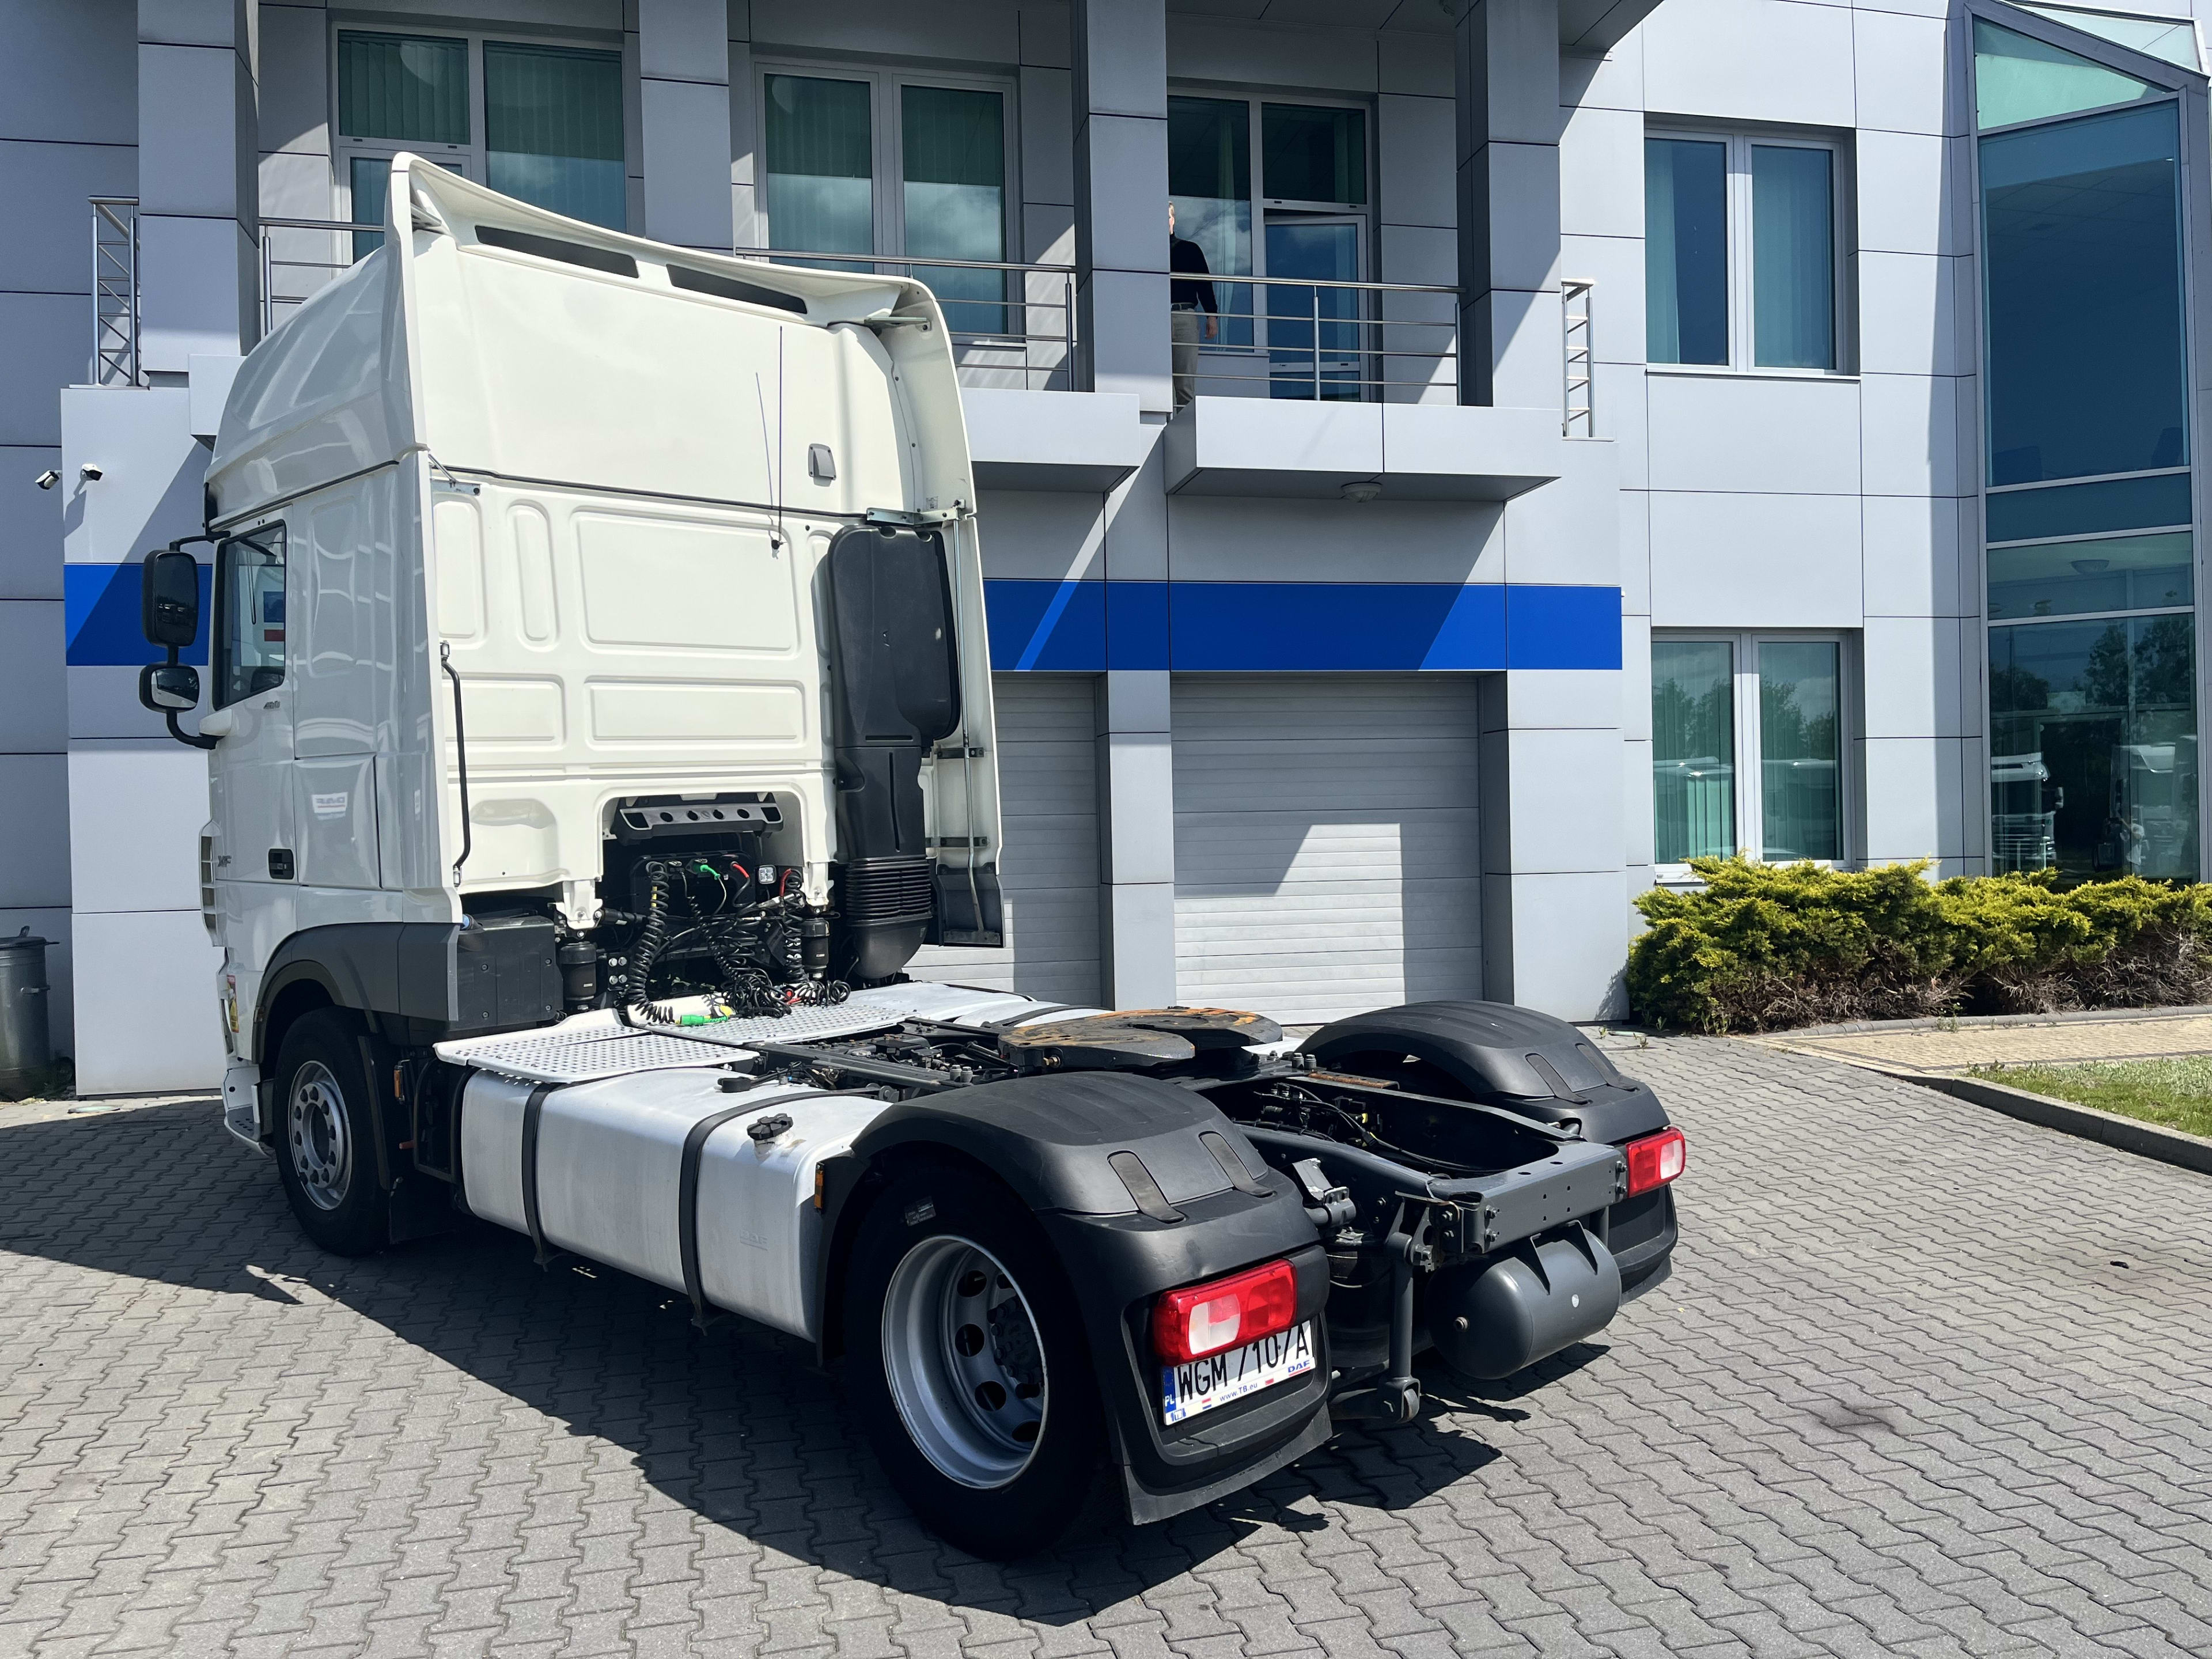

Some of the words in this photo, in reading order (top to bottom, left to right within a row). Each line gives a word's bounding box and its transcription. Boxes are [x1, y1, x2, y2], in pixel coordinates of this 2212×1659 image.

[218, 855, 232, 868] XF
[1287, 1359, 1310, 1373] DAF
[1177, 1353, 1228, 1404] WGM
[1219, 1382, 1257, 1402] www.TB.eu
[1165, 1394, 1175, 1407] PL
